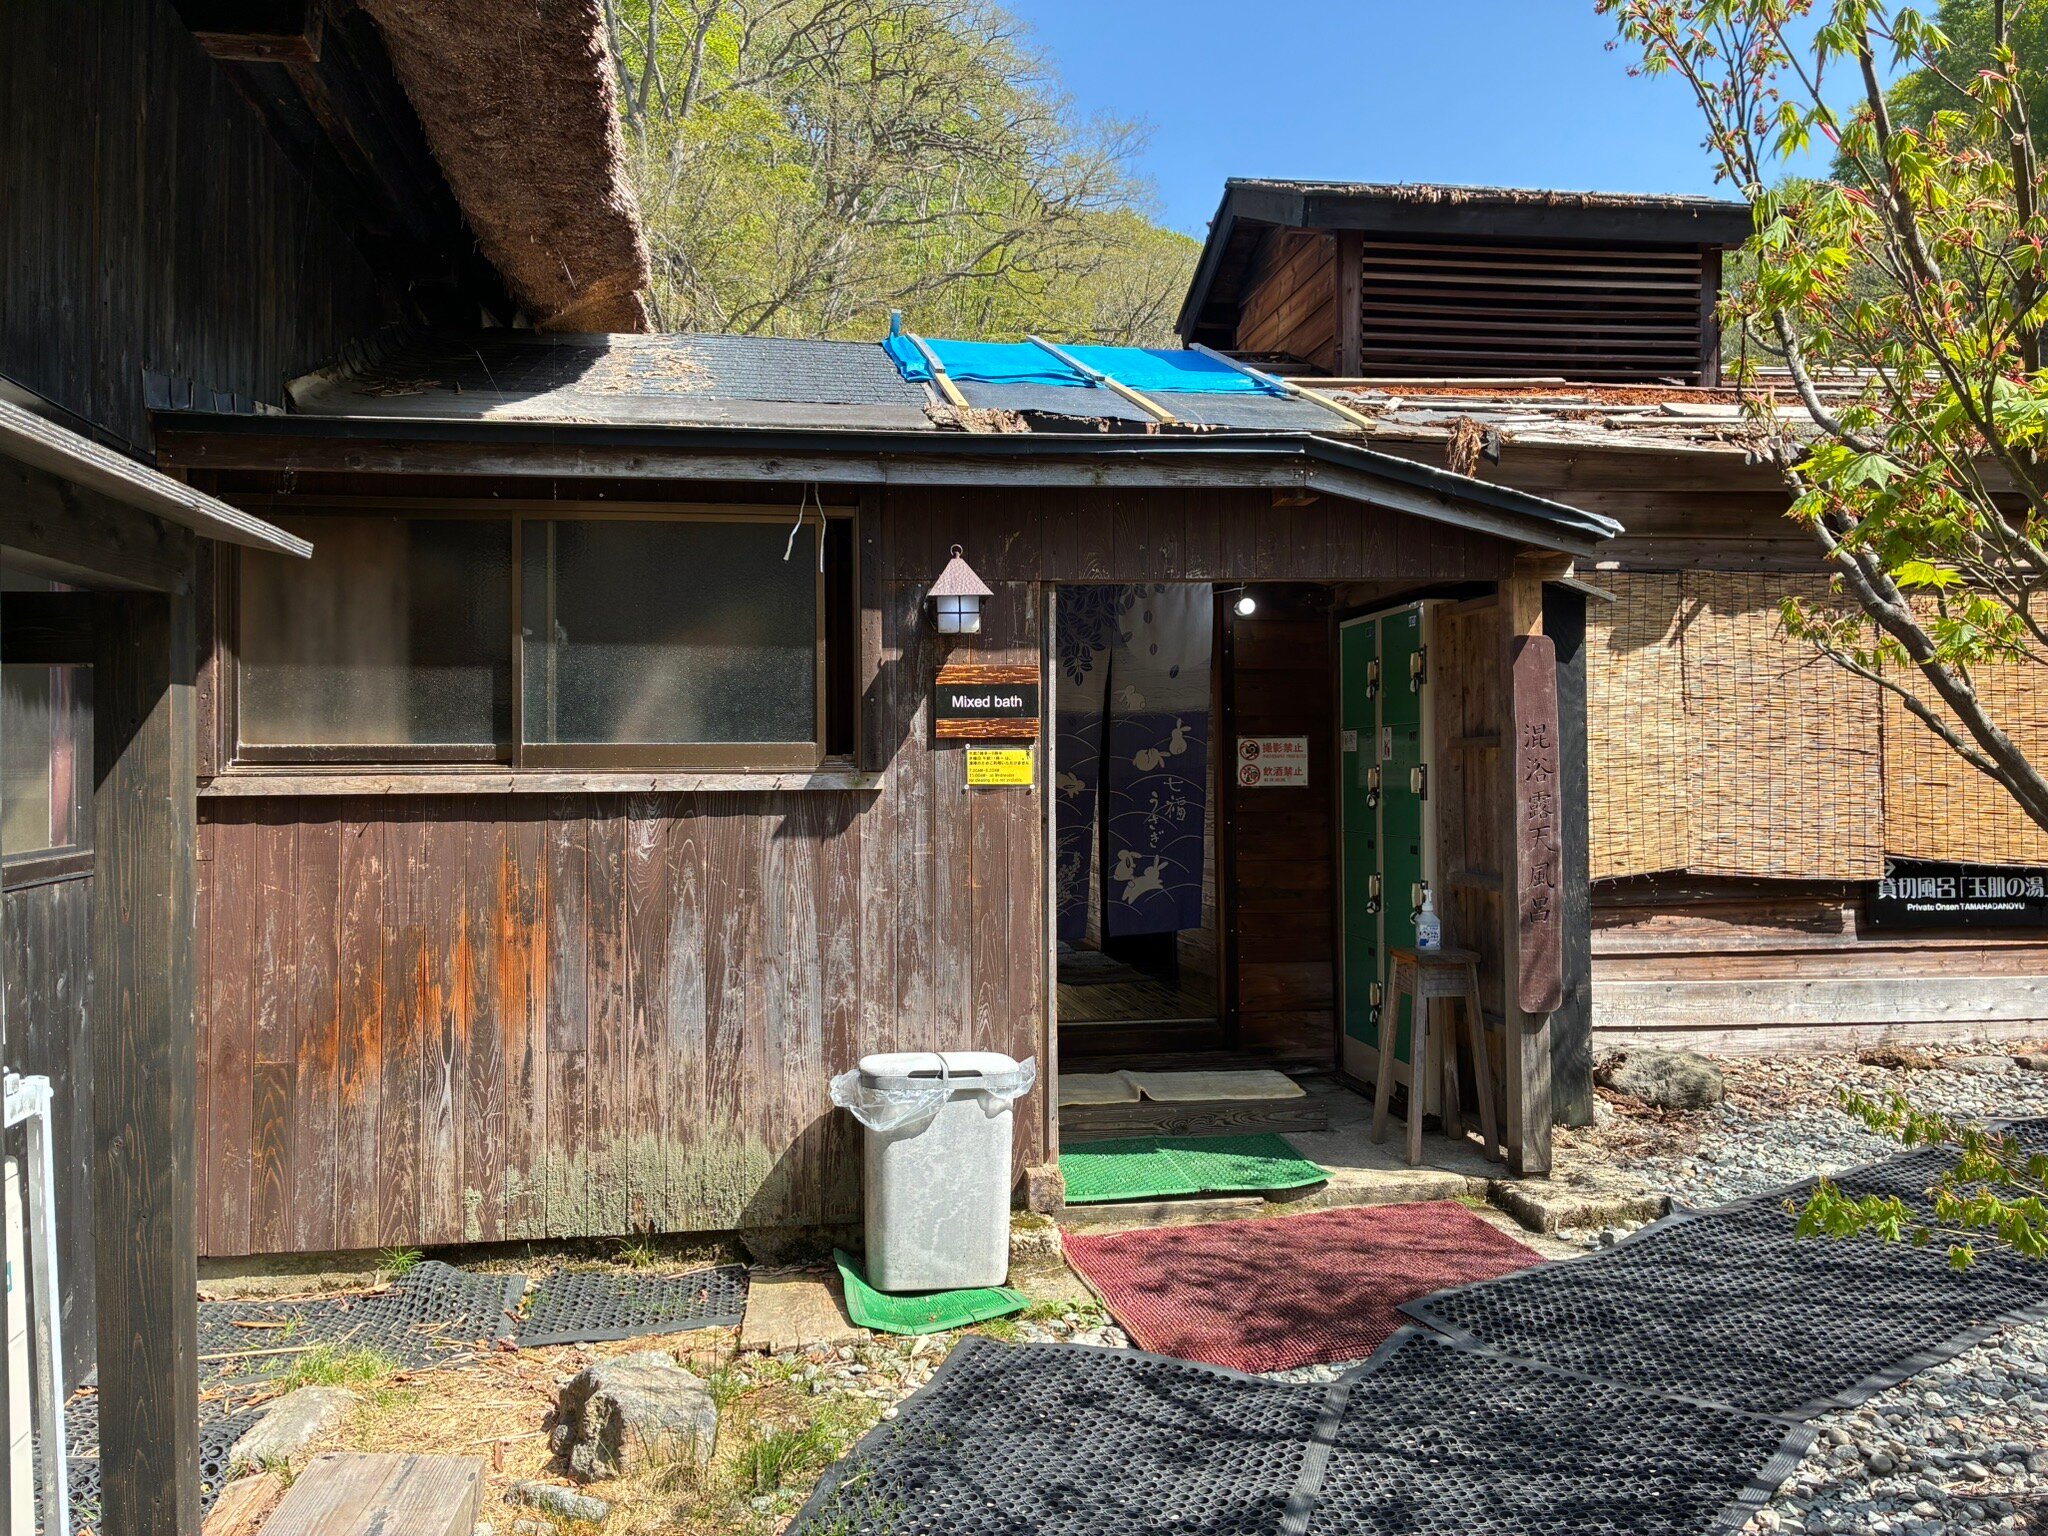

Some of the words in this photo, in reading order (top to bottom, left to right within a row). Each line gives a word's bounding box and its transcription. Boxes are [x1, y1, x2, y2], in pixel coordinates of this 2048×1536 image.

[951, 695, 990, 708] Mixed
[994, 695, 1023, 708] bath
[1262, 742, 1304, 753] 撮影禁止
[1263, 766, 1304, 777] 飲酒禁止
[1523, 723, 1556, 924] 混浴露天風呂
[1907, 903, 1935, 911] Private
[1935, 903, 1960, 911] Onsen
[1960, 902, 2025, 910] TAMAHADANOYU
